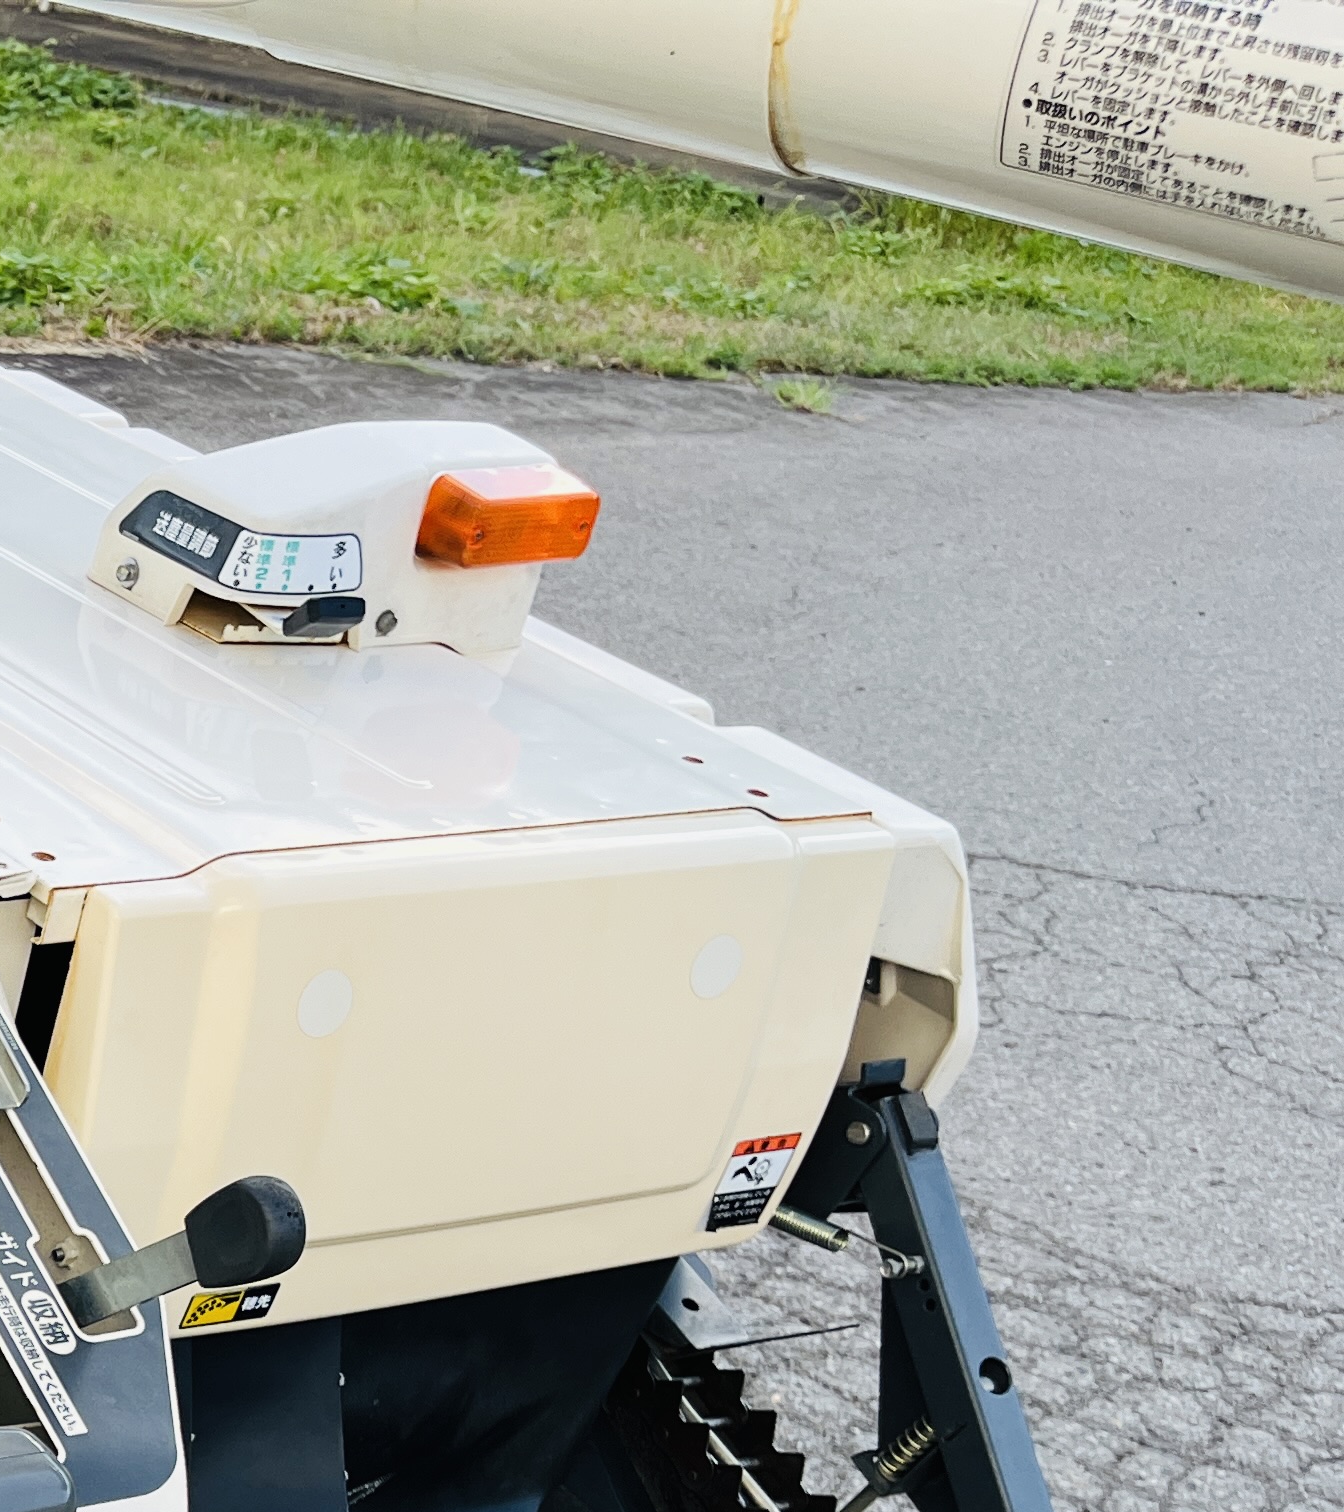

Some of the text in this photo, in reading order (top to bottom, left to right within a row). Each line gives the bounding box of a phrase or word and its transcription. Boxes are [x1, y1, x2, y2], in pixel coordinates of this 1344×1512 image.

[233, 536, 259, 578] 少ない
[329, 540, 347, 582] 多い
[27, 1297, 70, 1346] 収納
